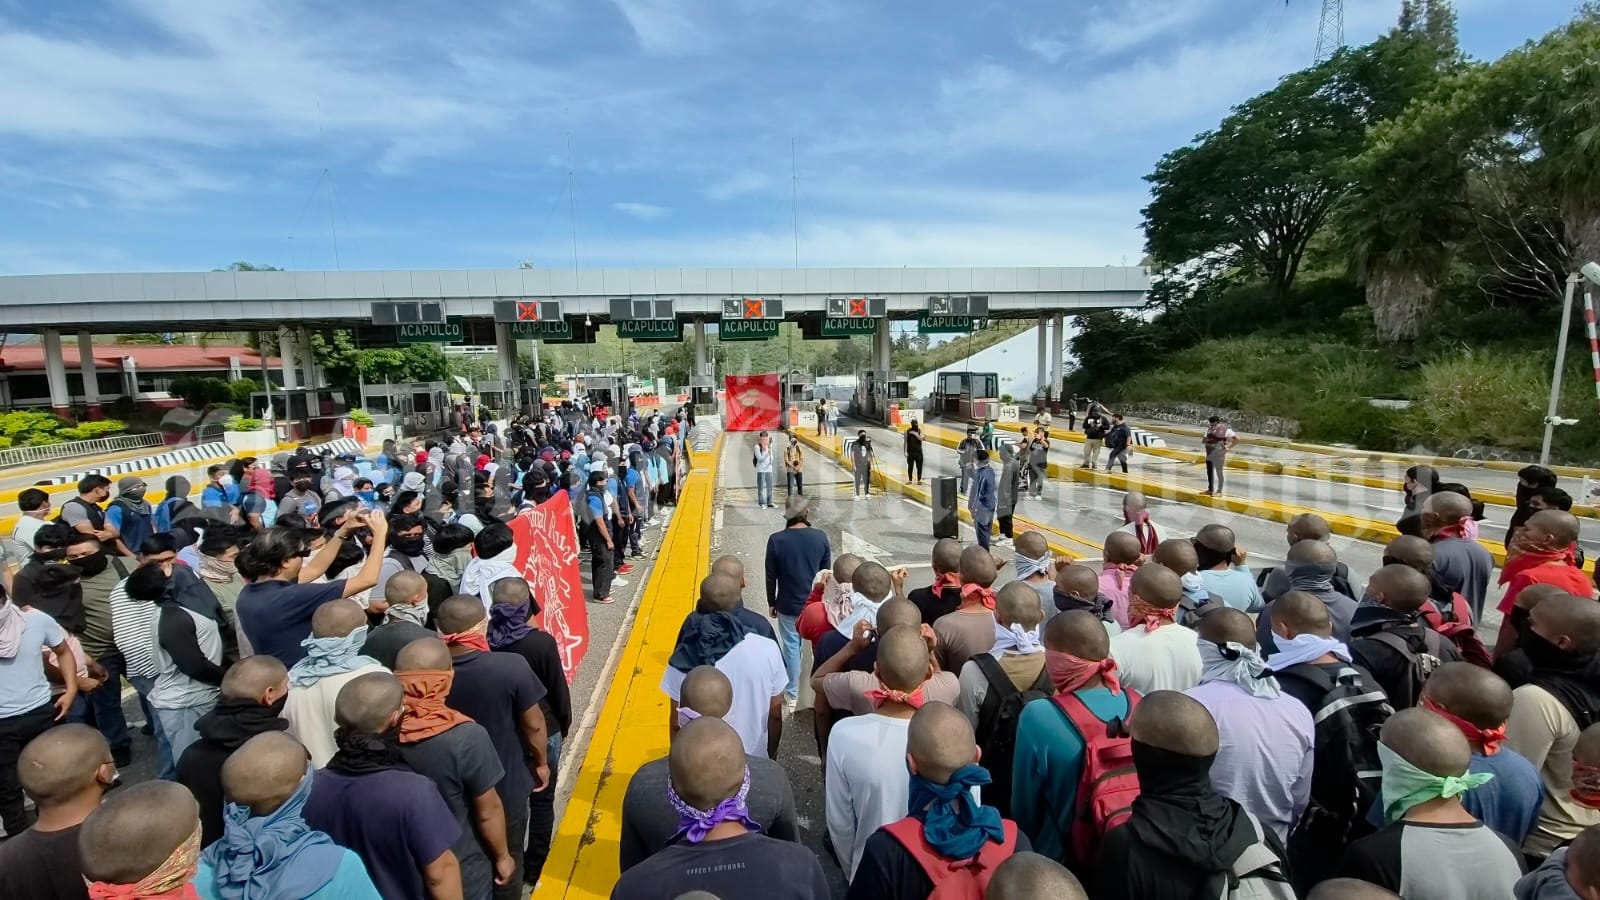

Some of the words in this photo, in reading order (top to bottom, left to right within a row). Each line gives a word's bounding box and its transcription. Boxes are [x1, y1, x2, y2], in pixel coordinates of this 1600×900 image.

[512, 320, 568, 335] ACAPULCO
[621, 319, 675, 333] ACAPULCO
[724, 319, 776, 333] ACAPULCO
[825, 317, 875, 330] ACAPULCO
[921, 316, 969, 328] ACAPULCO
[400, 324, 460, 338] ACAPULCO
